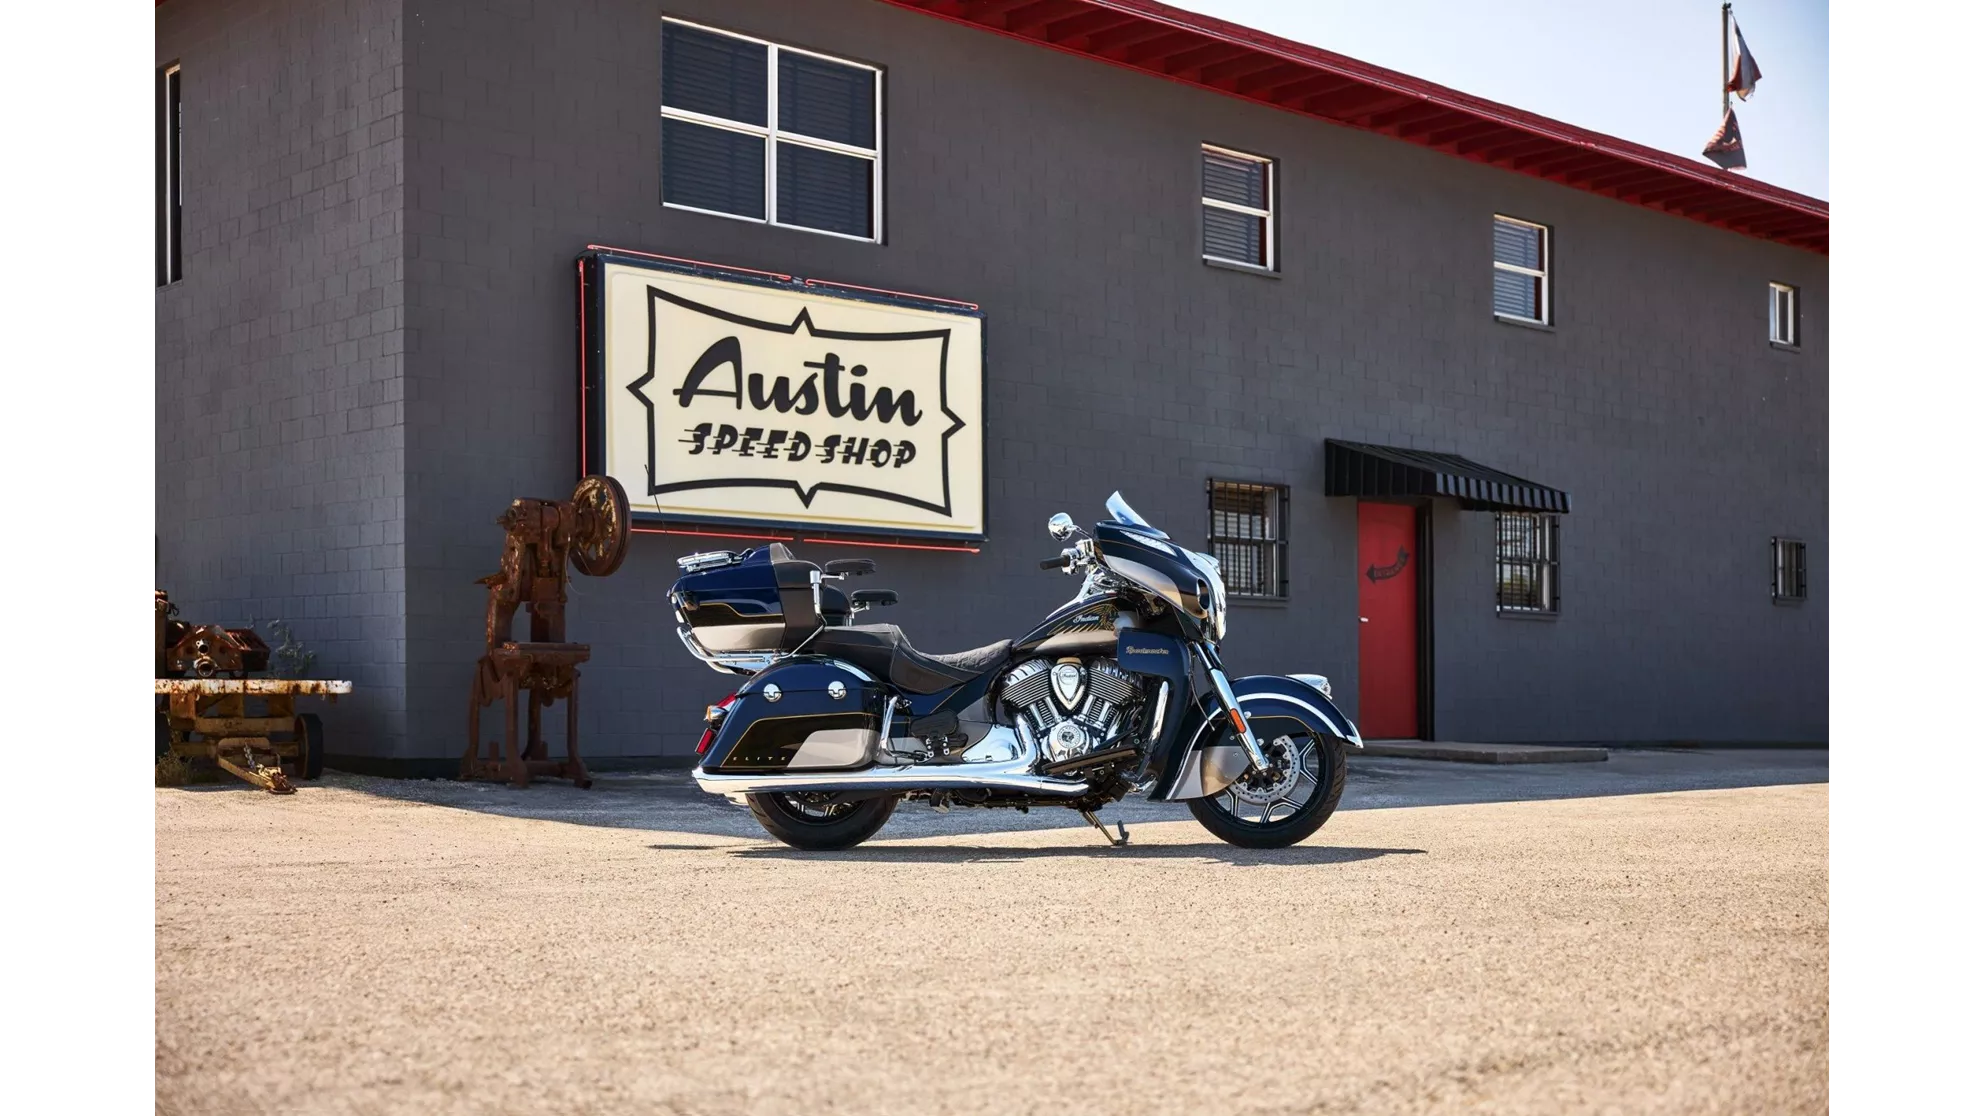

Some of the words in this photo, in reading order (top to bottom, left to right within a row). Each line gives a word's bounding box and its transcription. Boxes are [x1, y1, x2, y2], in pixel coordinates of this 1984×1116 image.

[672, 336, 923, 427] Austin
[678, 423, 812, 462] SPEED
[814, 435, 917, 468] SHOP
